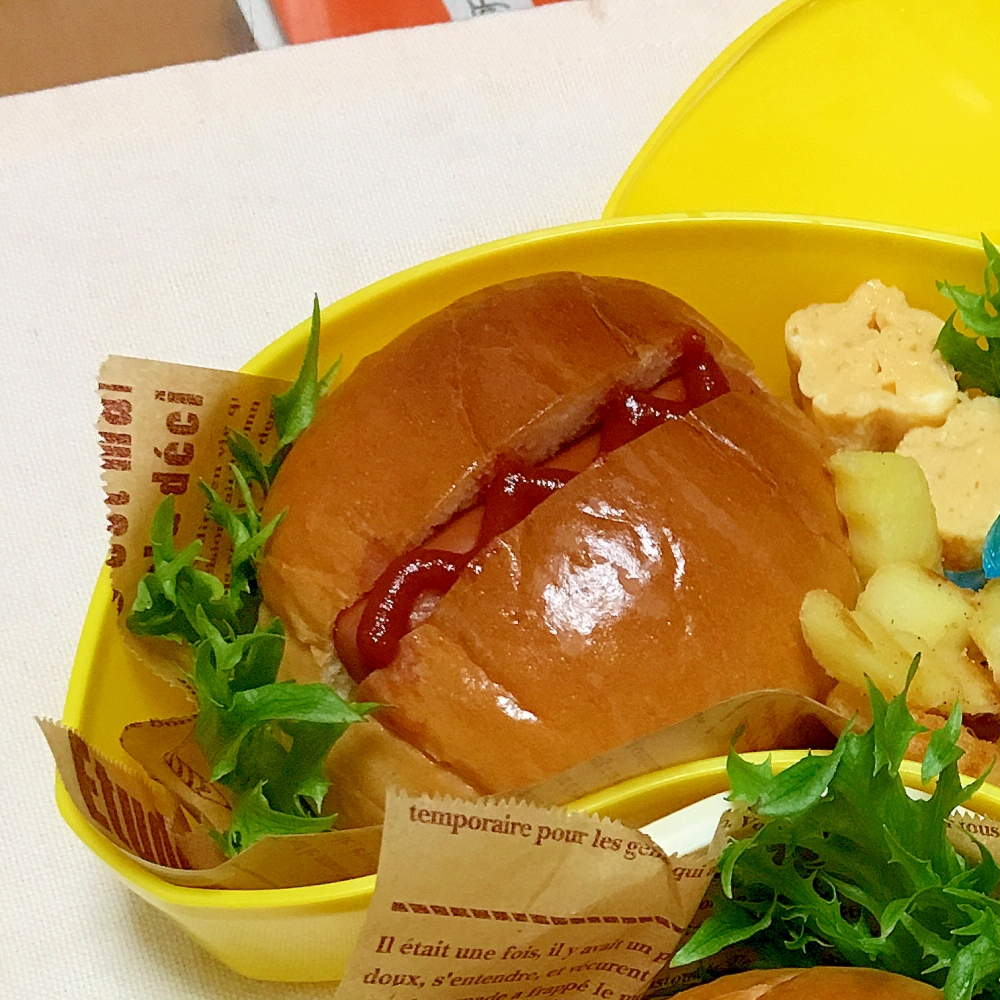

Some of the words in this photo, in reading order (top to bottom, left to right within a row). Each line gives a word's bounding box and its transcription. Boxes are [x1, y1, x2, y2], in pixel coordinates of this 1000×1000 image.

[409, 803, 532, 838] temporaire
[535, 823, 588, 846] pour
[592, 828, 622, 851] les
[672, 863, 706, 881] qui
[375, 935, 395, 954] Il
[400, 937, 451, 958] était
[455, 946, 496, 960] une
[502, 945, 541, 960] fois,
[546, 942, 565, 957] il
[561, 945, 579, 961] y
[626, 940, 653, 955] un
[363, 967, 425, 990] doux,
[431, 969, 540, 987] s'entendre,
[546, 965, 567, 978] et
[526, 979, 591, 998] frappé
[592, 982, 614, 999] le
